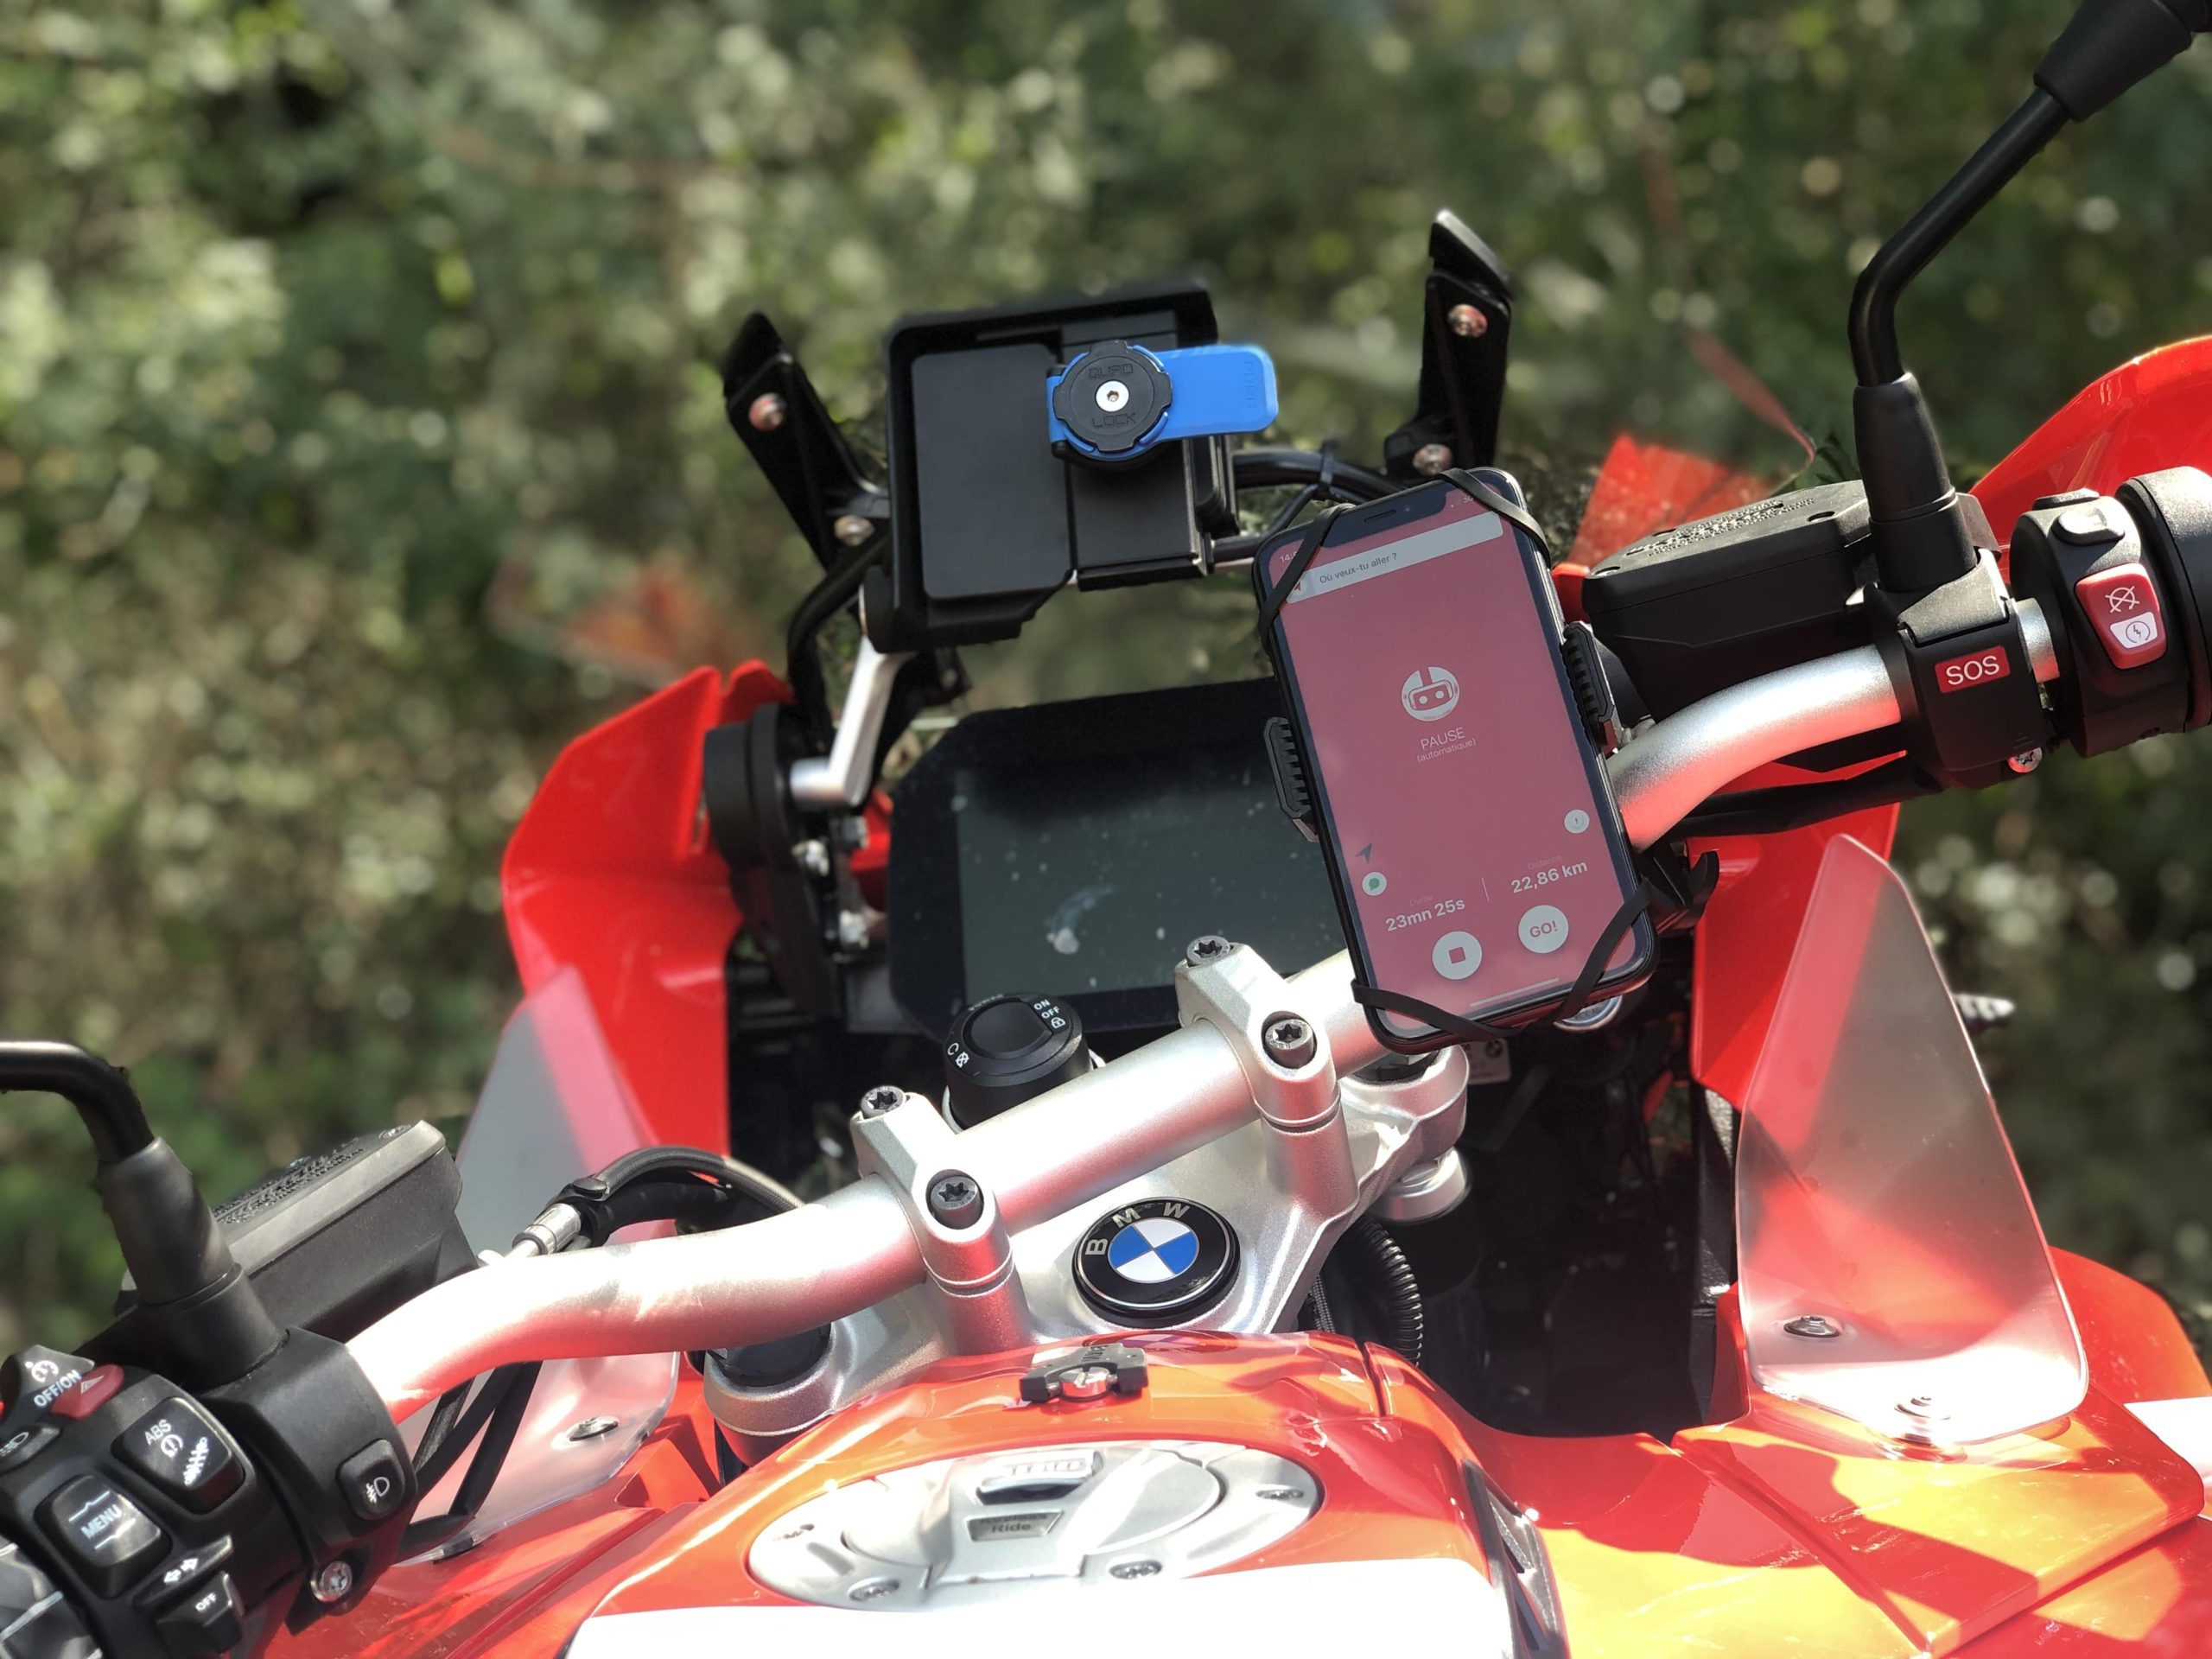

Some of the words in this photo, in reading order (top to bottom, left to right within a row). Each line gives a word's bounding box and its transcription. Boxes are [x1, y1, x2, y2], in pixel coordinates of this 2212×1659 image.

[1088, 364, 1134, 379] QUAD
[1090, 411, 1137, 428] LOCK
[1319, 573, 1333, 584] Où
[1334, 563, 1370, 578] veux-tu
[1370, 556, 1391, 568] aller
[1391, 553, 1398, 562] ?
[1946, 655, 1999, 685] SOS
[1417, 738, 1476, 763] (automatique)
[1421, 727, 1465, 750] PAUSE
[1511, 868, 1560, 893] 22,86
[1562, 862, 1588, 878] km
[1385, 909, 1433, 931] 23mn
[1434, 899, 1465, 917] 25s
[1529, 920, 1558, 938] GO!
[1033, 999, 1051, 1011] ON
[1041, 1006, 1060, 1019] OFF
[1084, 1201, 1190, 1255] BMW
[34, 1370, 82, 1407] OFF/ON
[144, 1419, 172, 1446] ABS
[80, 1503, 123, 1540] MENU
[991, 1522, 1031, 1534] Ride
[195, 1592, 216, 1612] OFF
